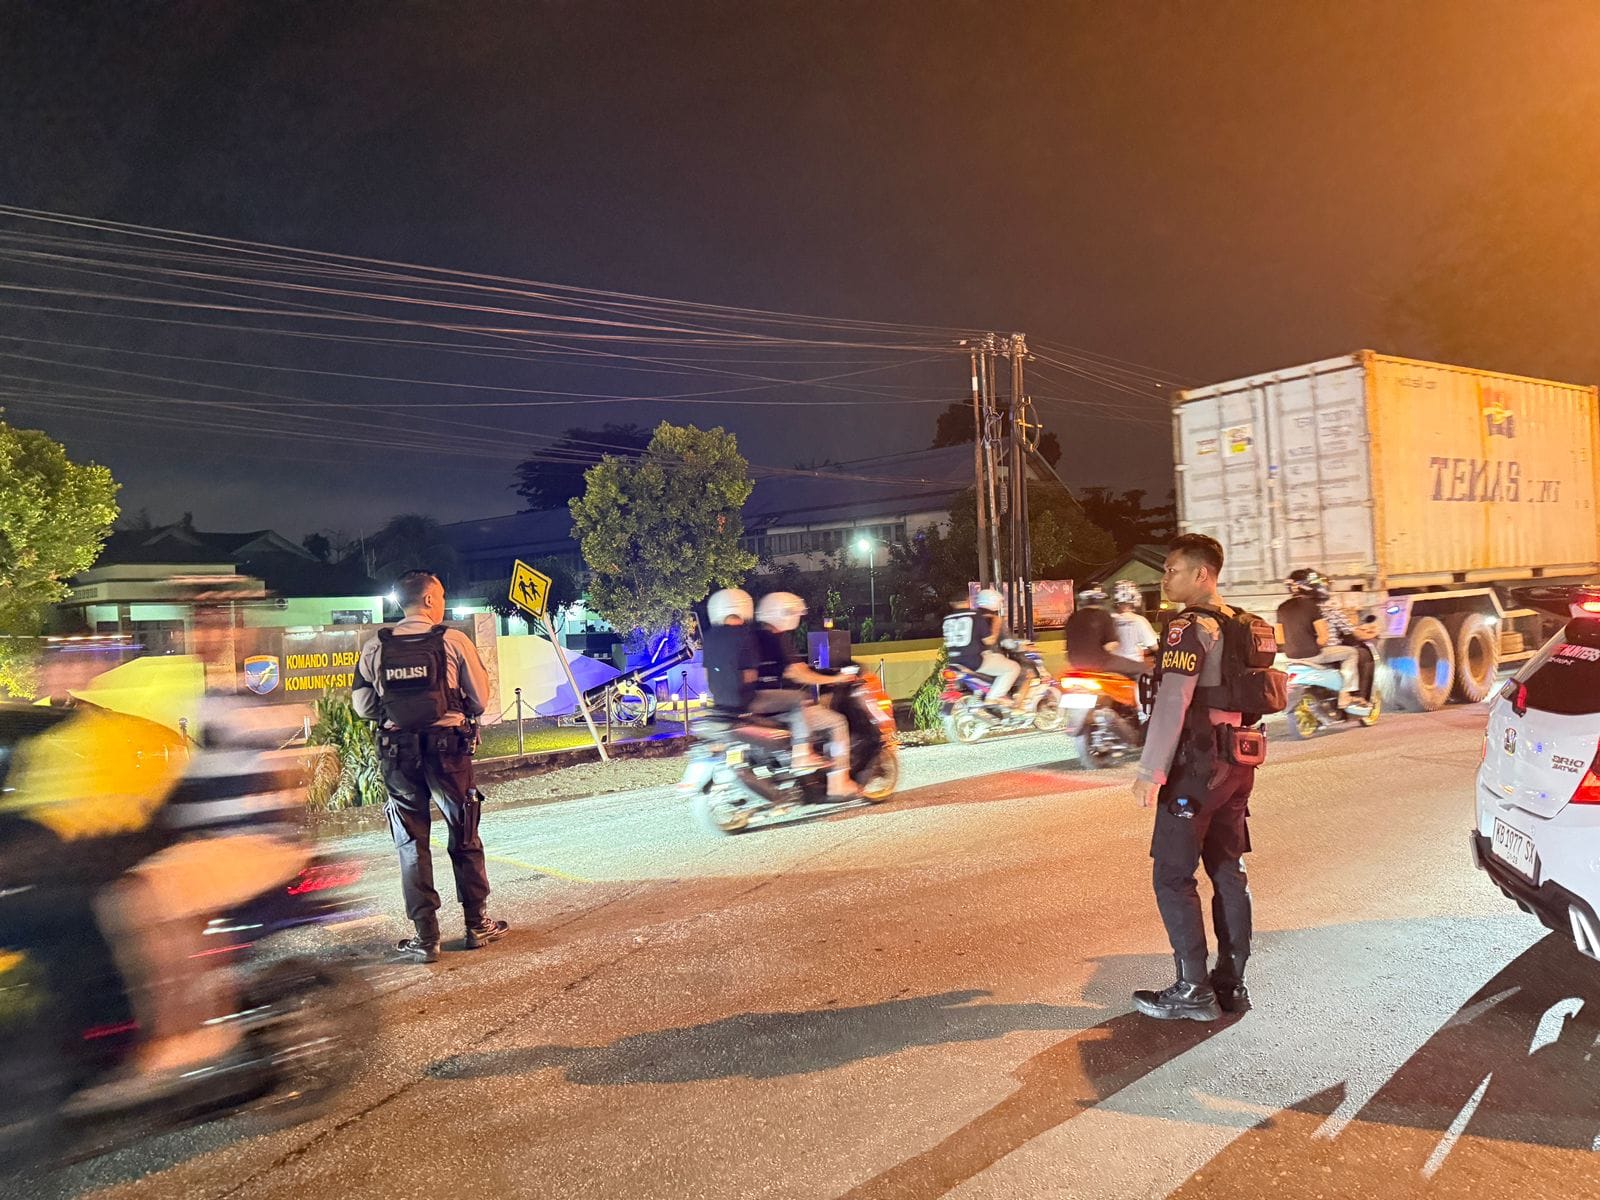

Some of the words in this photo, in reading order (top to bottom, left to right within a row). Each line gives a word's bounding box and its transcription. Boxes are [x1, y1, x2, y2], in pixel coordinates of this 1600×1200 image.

[286, 653, 329, 670] KOMANDO
[332, 651, 362, 667] DAERA
[386, 666, 428, 681] POLISI
[285, 674, 346, 691] KOMUNIKASI
[1551, 755, 1585, 768] BRIO
[1496, 822, 1506, 844] KB
[1505, 829, 1523, 854] 1977
[1525, 840, 1536, 865] SX
